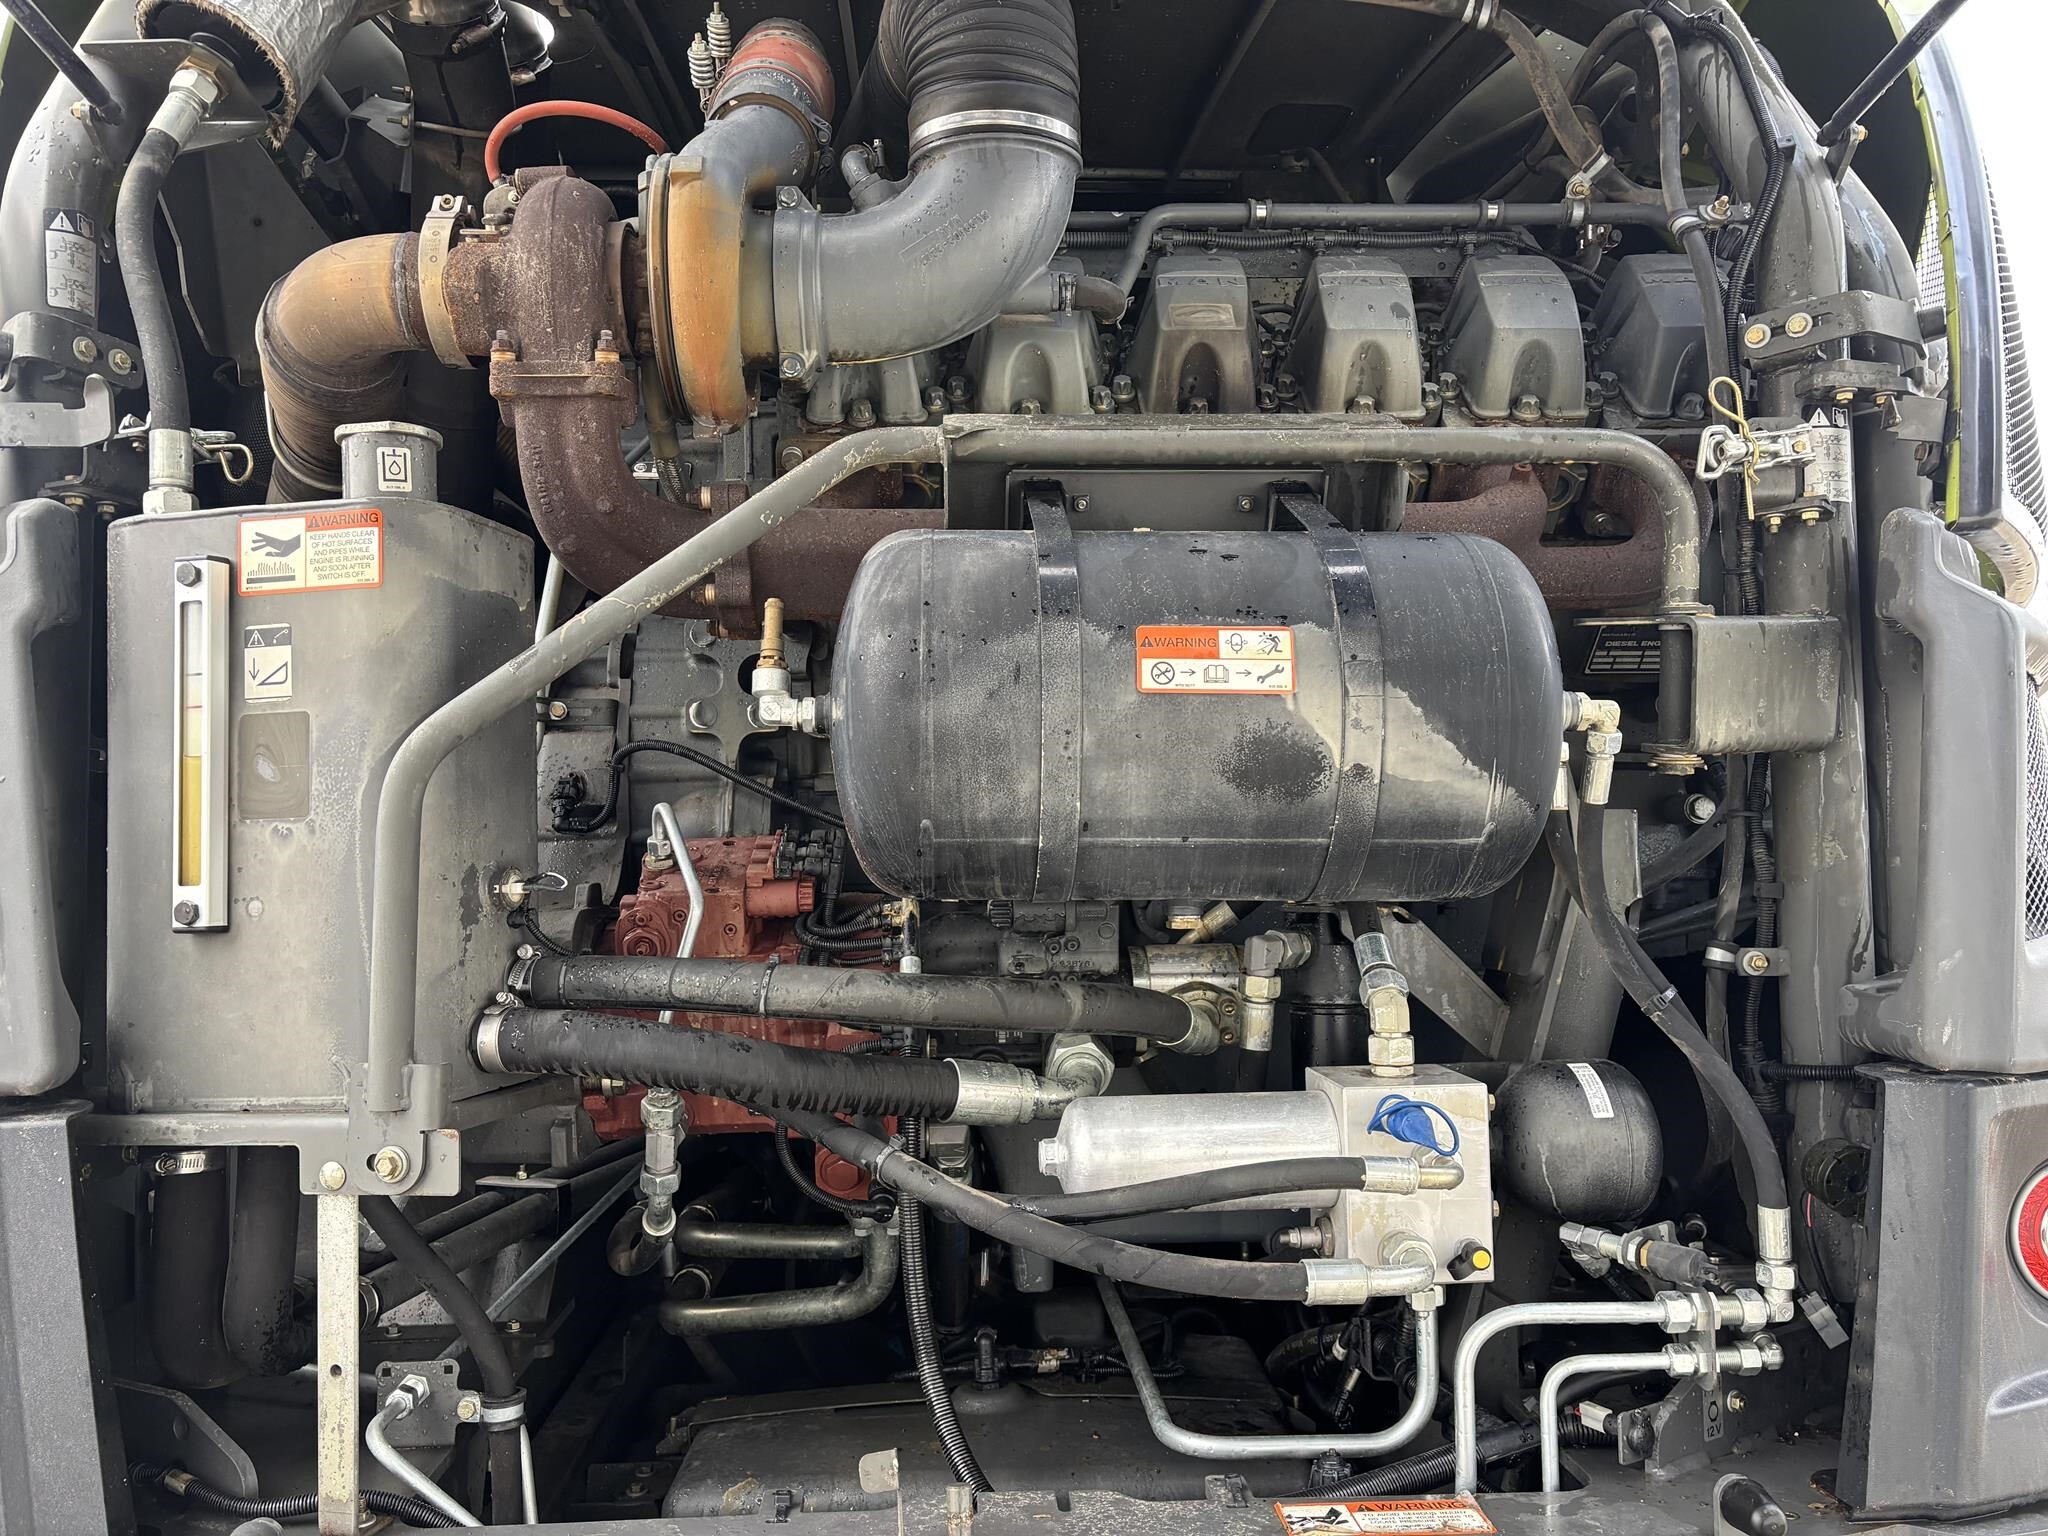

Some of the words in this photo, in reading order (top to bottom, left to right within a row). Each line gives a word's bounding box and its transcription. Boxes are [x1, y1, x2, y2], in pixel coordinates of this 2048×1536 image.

[320, 512, 379, 526] WARNING
[310, 533, 327, 541] KEEP
[327, 531, 351, 539] HANDS
[351, 529, 375, 538] CLEAR
[311, 541, 321, 549] OF
[321, 540, 336, 548] HOT
[337, 537, 373, 546] SURFACES
[313, 549, 328, 557] AND
[328, 547, 348, 555] PIPES
[348, 545, 371, 554] WHILE
[309, 556, 334, 565] ENGINE
[342, 553, 375, 562] RUNNING
[312, 565, 328, 573] AND
[328, 563, 348, 572] SOON
[348, 562, 372, 570] AFTER
[317, 572, 343, 581] SWITCH
[1154, 637, 1217, 648] WARNING
[1374, 1501, 1467, 1511] WARNING
